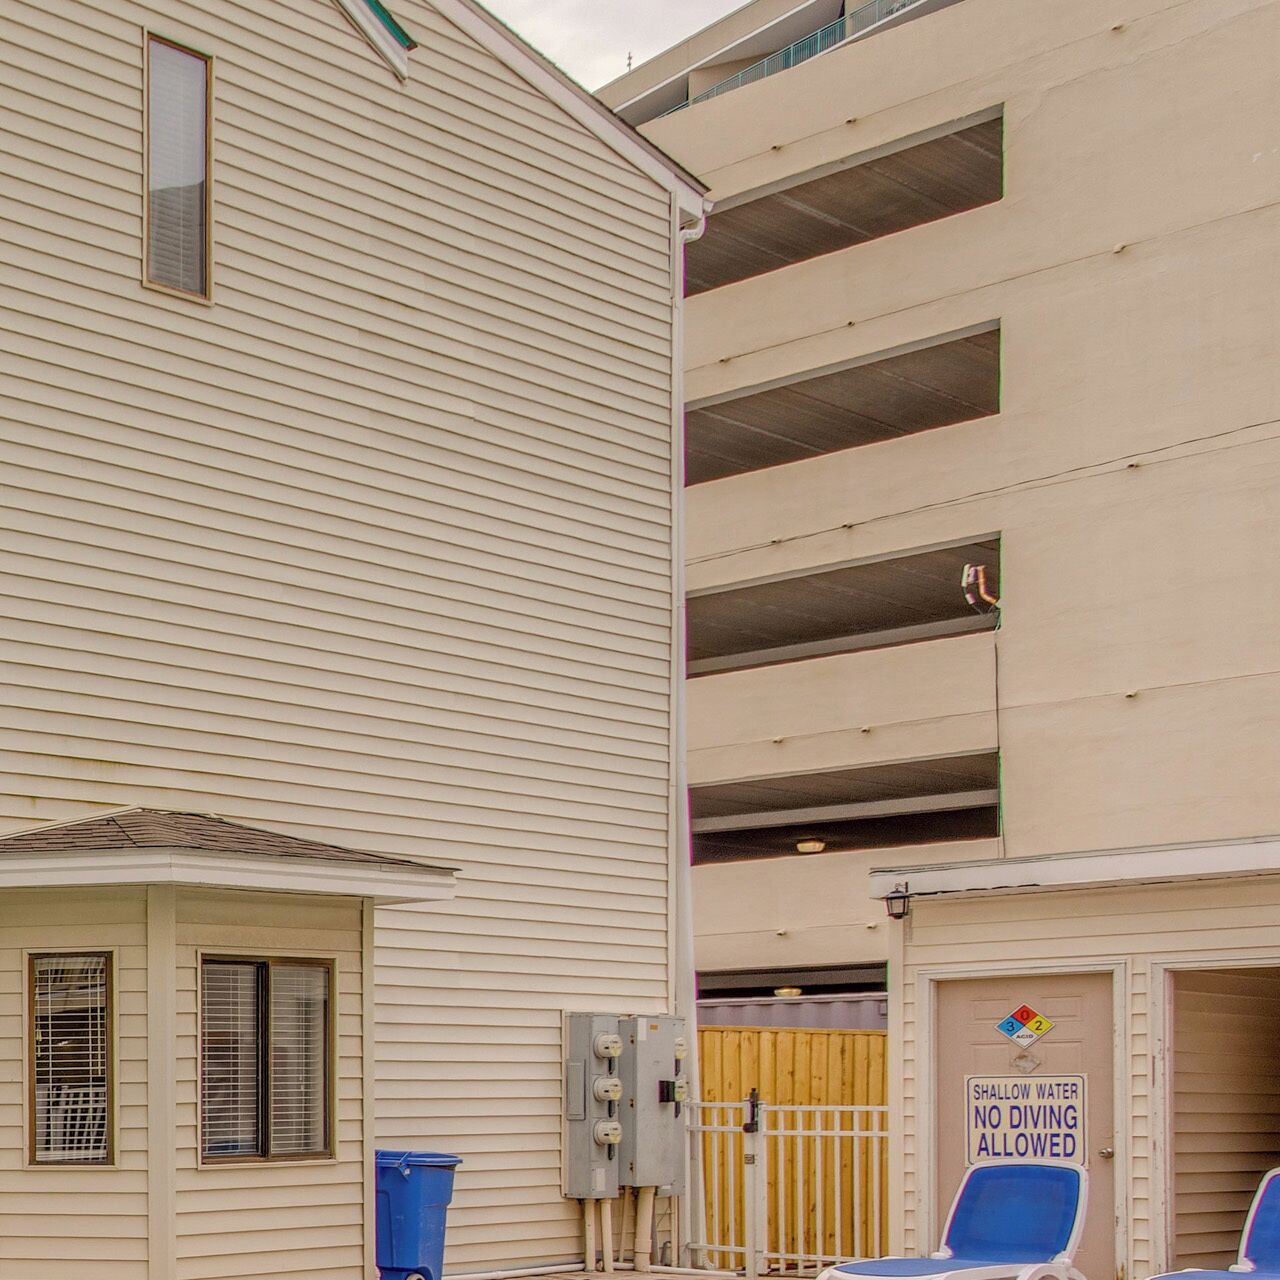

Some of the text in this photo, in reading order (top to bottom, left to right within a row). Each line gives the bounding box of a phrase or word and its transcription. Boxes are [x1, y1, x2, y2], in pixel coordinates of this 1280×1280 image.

[1021, 1010, 1029, 1020] 0
[1007, 1022, 1015, 1032] 3
[1035, 1020, 1043, 1031] 2
[973, 1083, 1079, 1100] SHALLOW WATER
[974, 1105, 1078, 1130] NO DIVING
[977, 1133, 1076, 1158] ALLOWED
